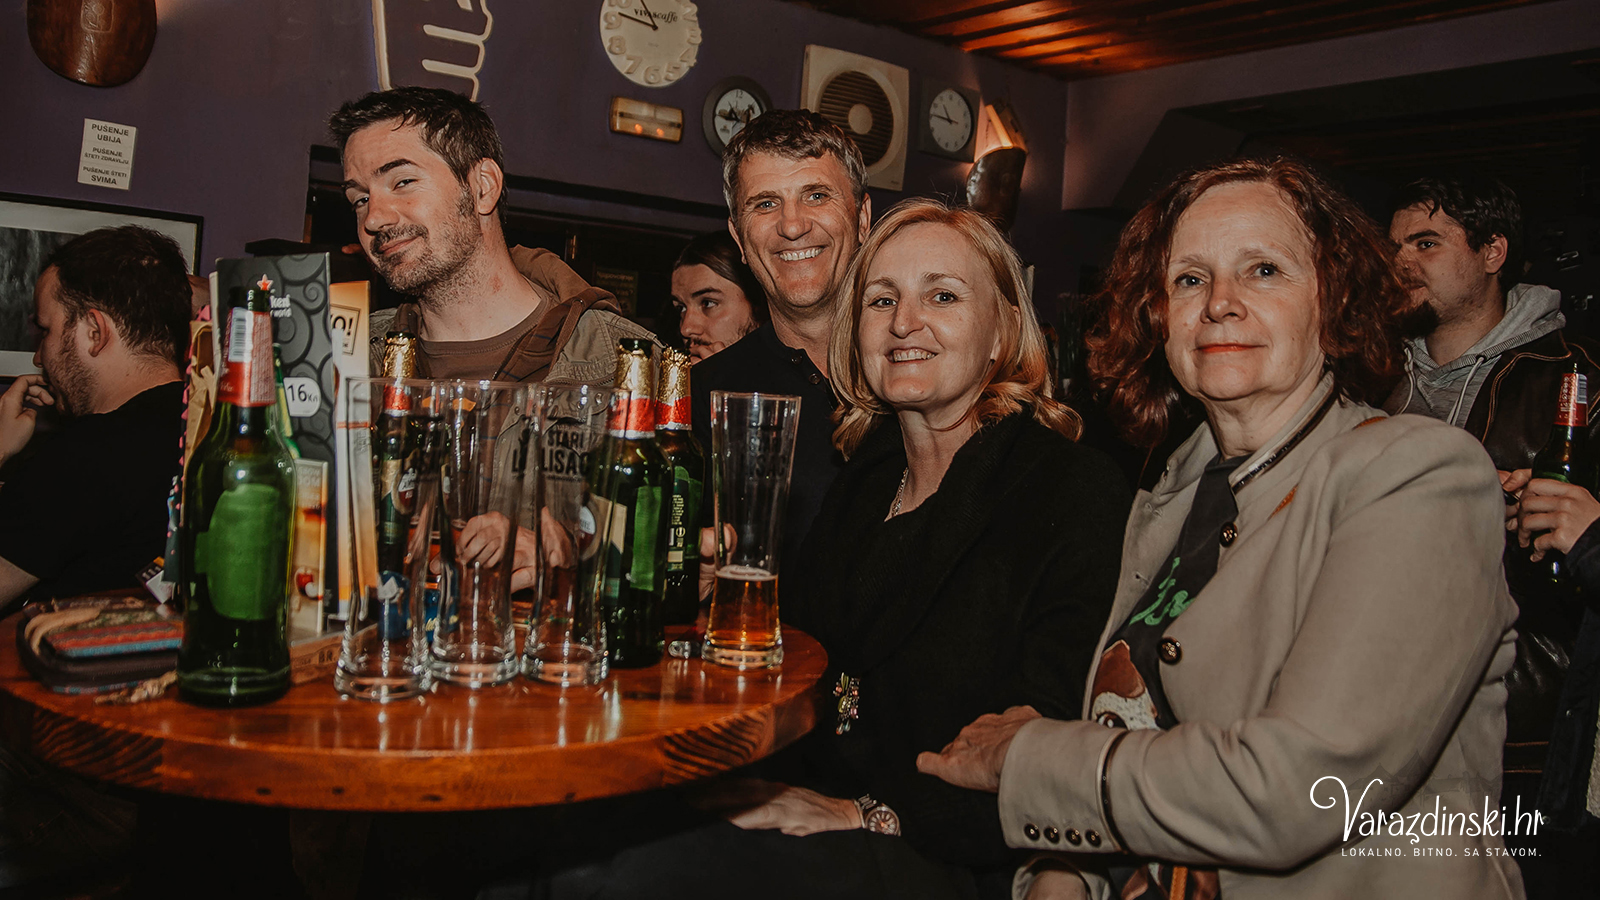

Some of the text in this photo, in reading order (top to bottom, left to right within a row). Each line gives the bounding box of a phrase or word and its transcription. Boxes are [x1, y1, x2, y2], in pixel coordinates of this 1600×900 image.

[91, 123, 129, 136] PUŠENJE
[97, 134, 122, 144] UBIJA
[84, 152, 100, 160] ŠTETI
[92, 147, 123, 157] PUŠENJE
[83, 166, 127, 178] PUŠENJE ŠTETI
[91, 174, 117, 185] SVIMA
[287, 384, 307, 402] 16
[547, 428, 584, 449] STARI
